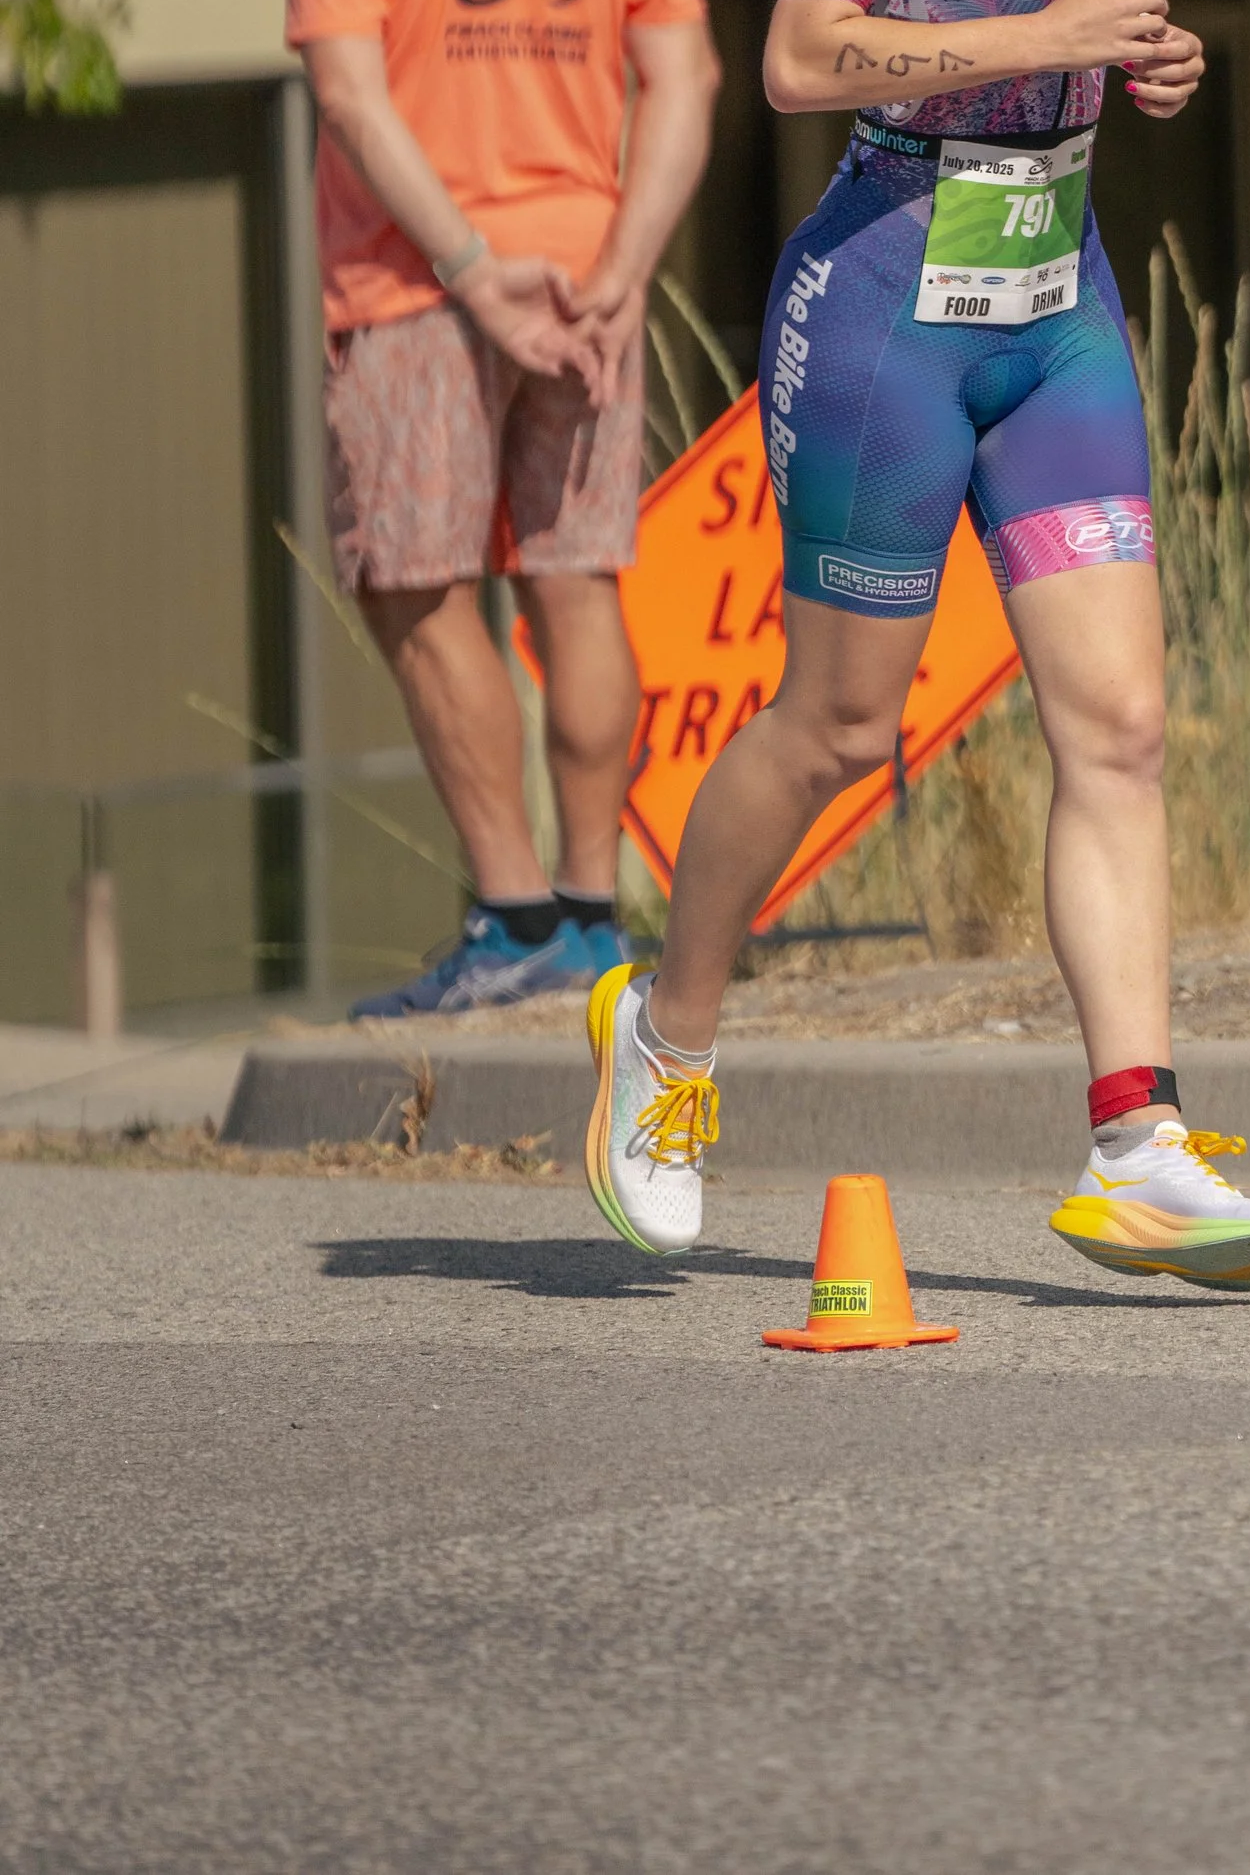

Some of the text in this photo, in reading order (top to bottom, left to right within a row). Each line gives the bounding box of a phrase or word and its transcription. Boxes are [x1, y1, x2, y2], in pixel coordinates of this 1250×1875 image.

[942, 155, 1014, 176] July 20, 2025
[944, 285, 1065, 317] FOOD DRINK
[769, 251, 834, 507] The Bike Barn
[828, 563, 929, 590] PRECISION
[828, 575, 928, 598] FUEL & HYDRATION
[831, 1285, 867, 1296] Classic
[812, 1297, 867, 1313] TRIATHLON
